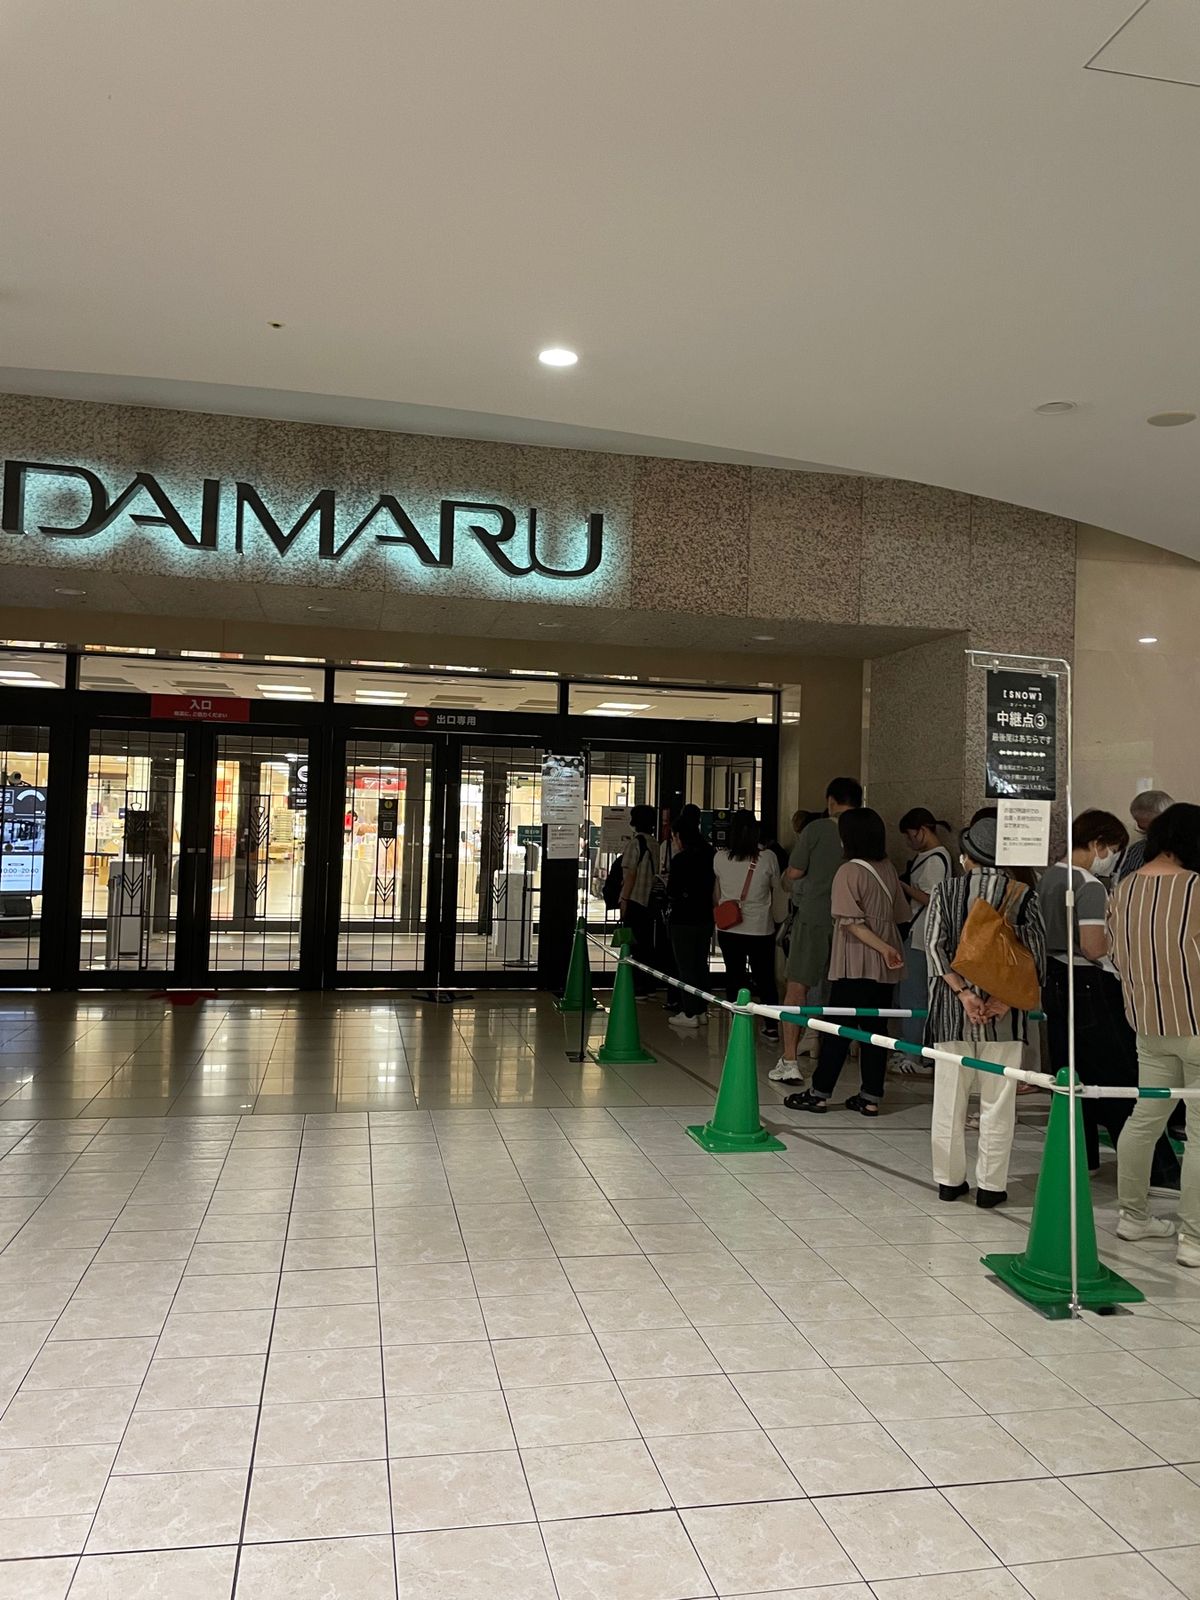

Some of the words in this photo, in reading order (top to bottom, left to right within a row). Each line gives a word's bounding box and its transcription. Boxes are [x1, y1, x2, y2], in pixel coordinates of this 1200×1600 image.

[2, 460, 604, 579] DAIMARU
[190, 699, 212, 710] 入口
[436, 714, 477, 726] 出口専用
